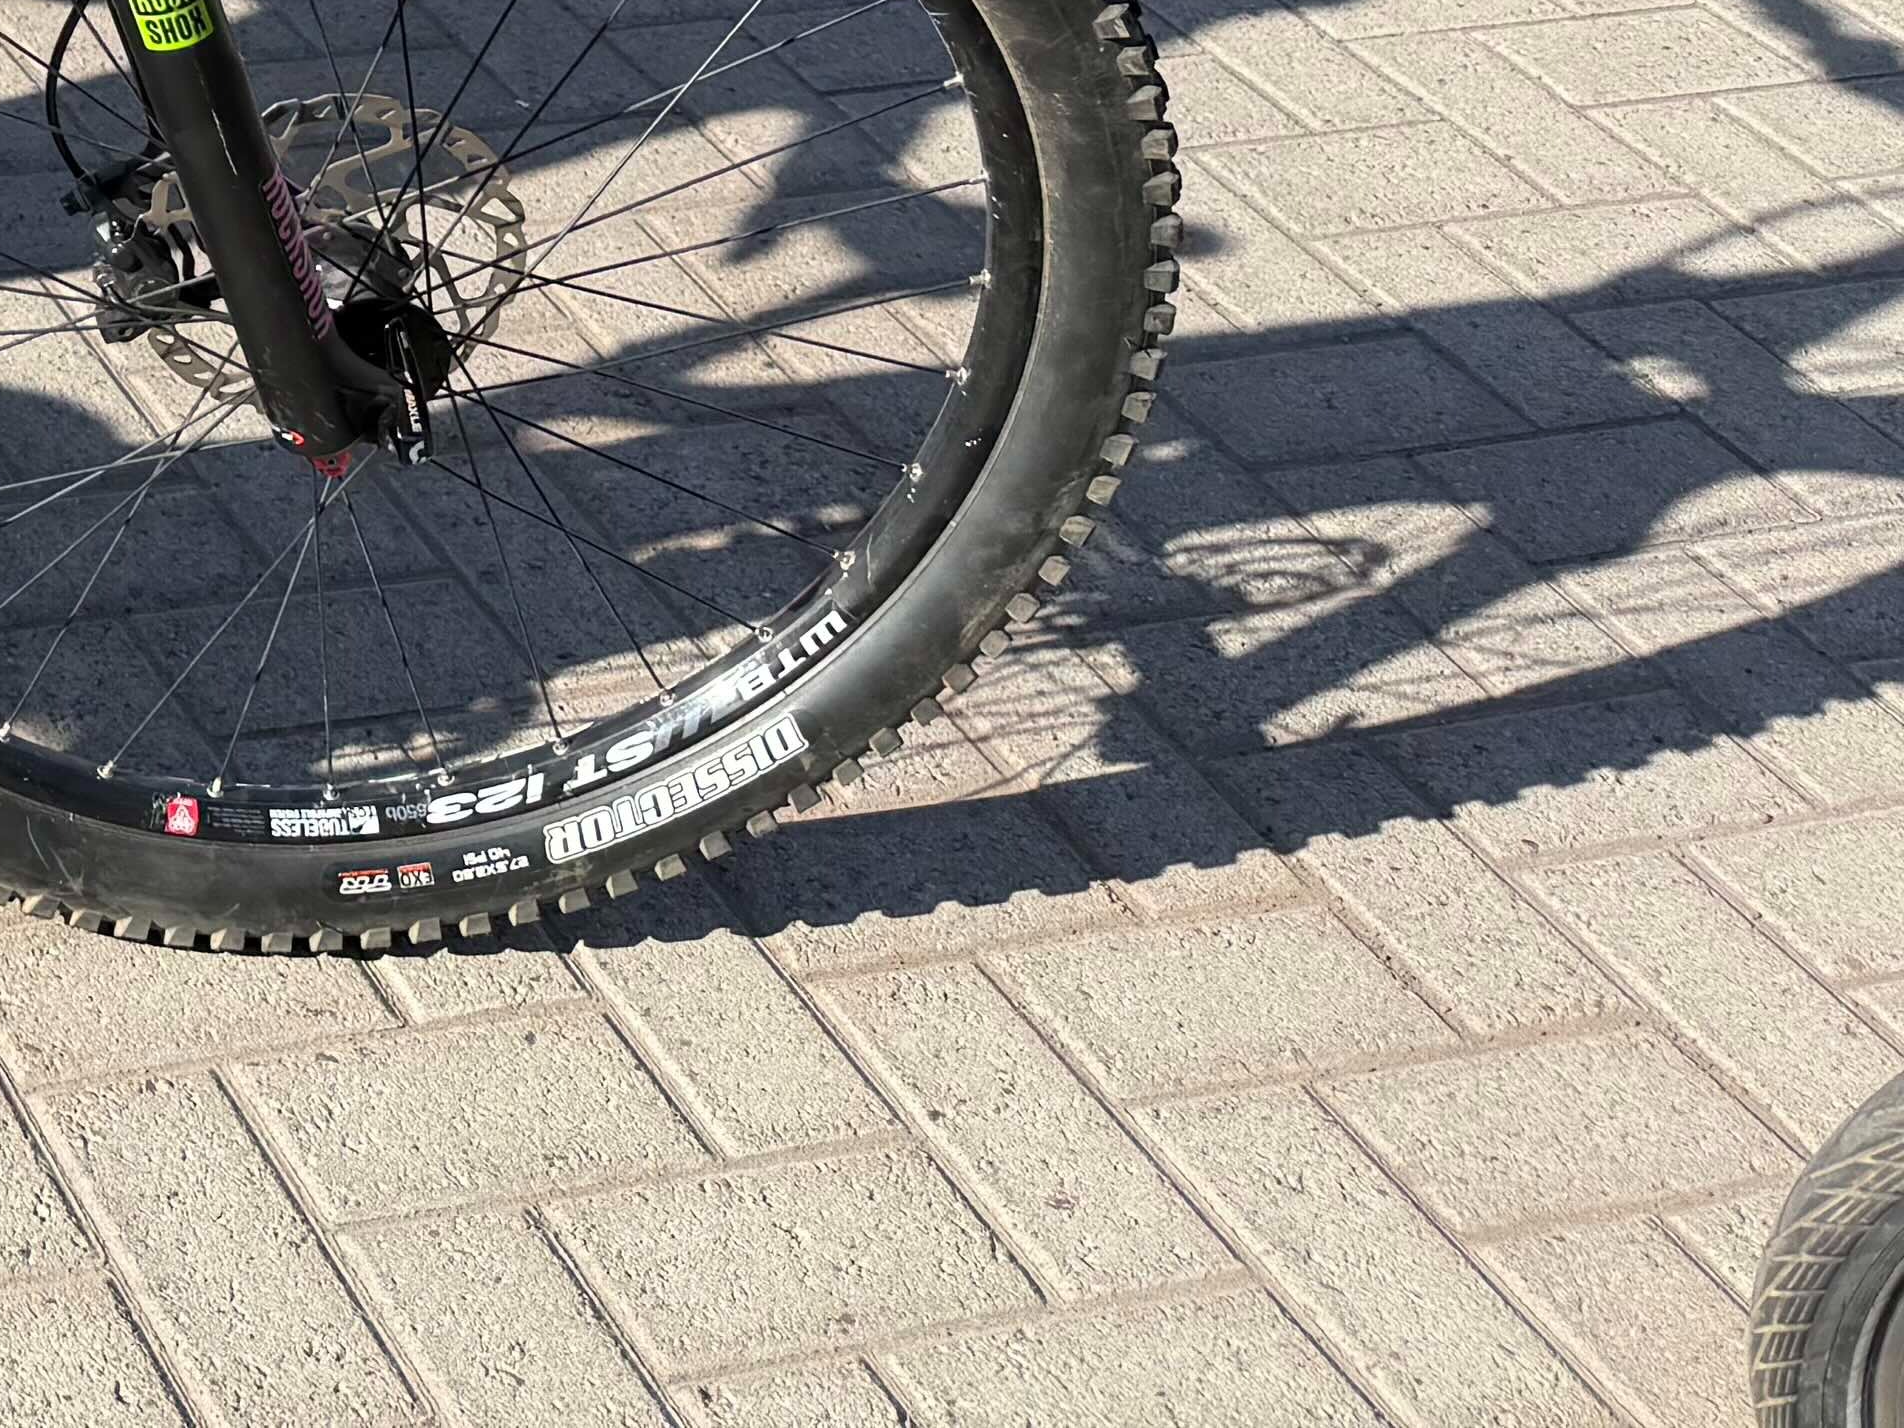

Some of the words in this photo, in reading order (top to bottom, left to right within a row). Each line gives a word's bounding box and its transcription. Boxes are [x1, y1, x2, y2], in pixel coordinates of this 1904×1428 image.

[144, 5, 208, 45] SHOX
[544, 713, 810, 865] DISSECTOR
[399, 868, 433, 889] EXO
